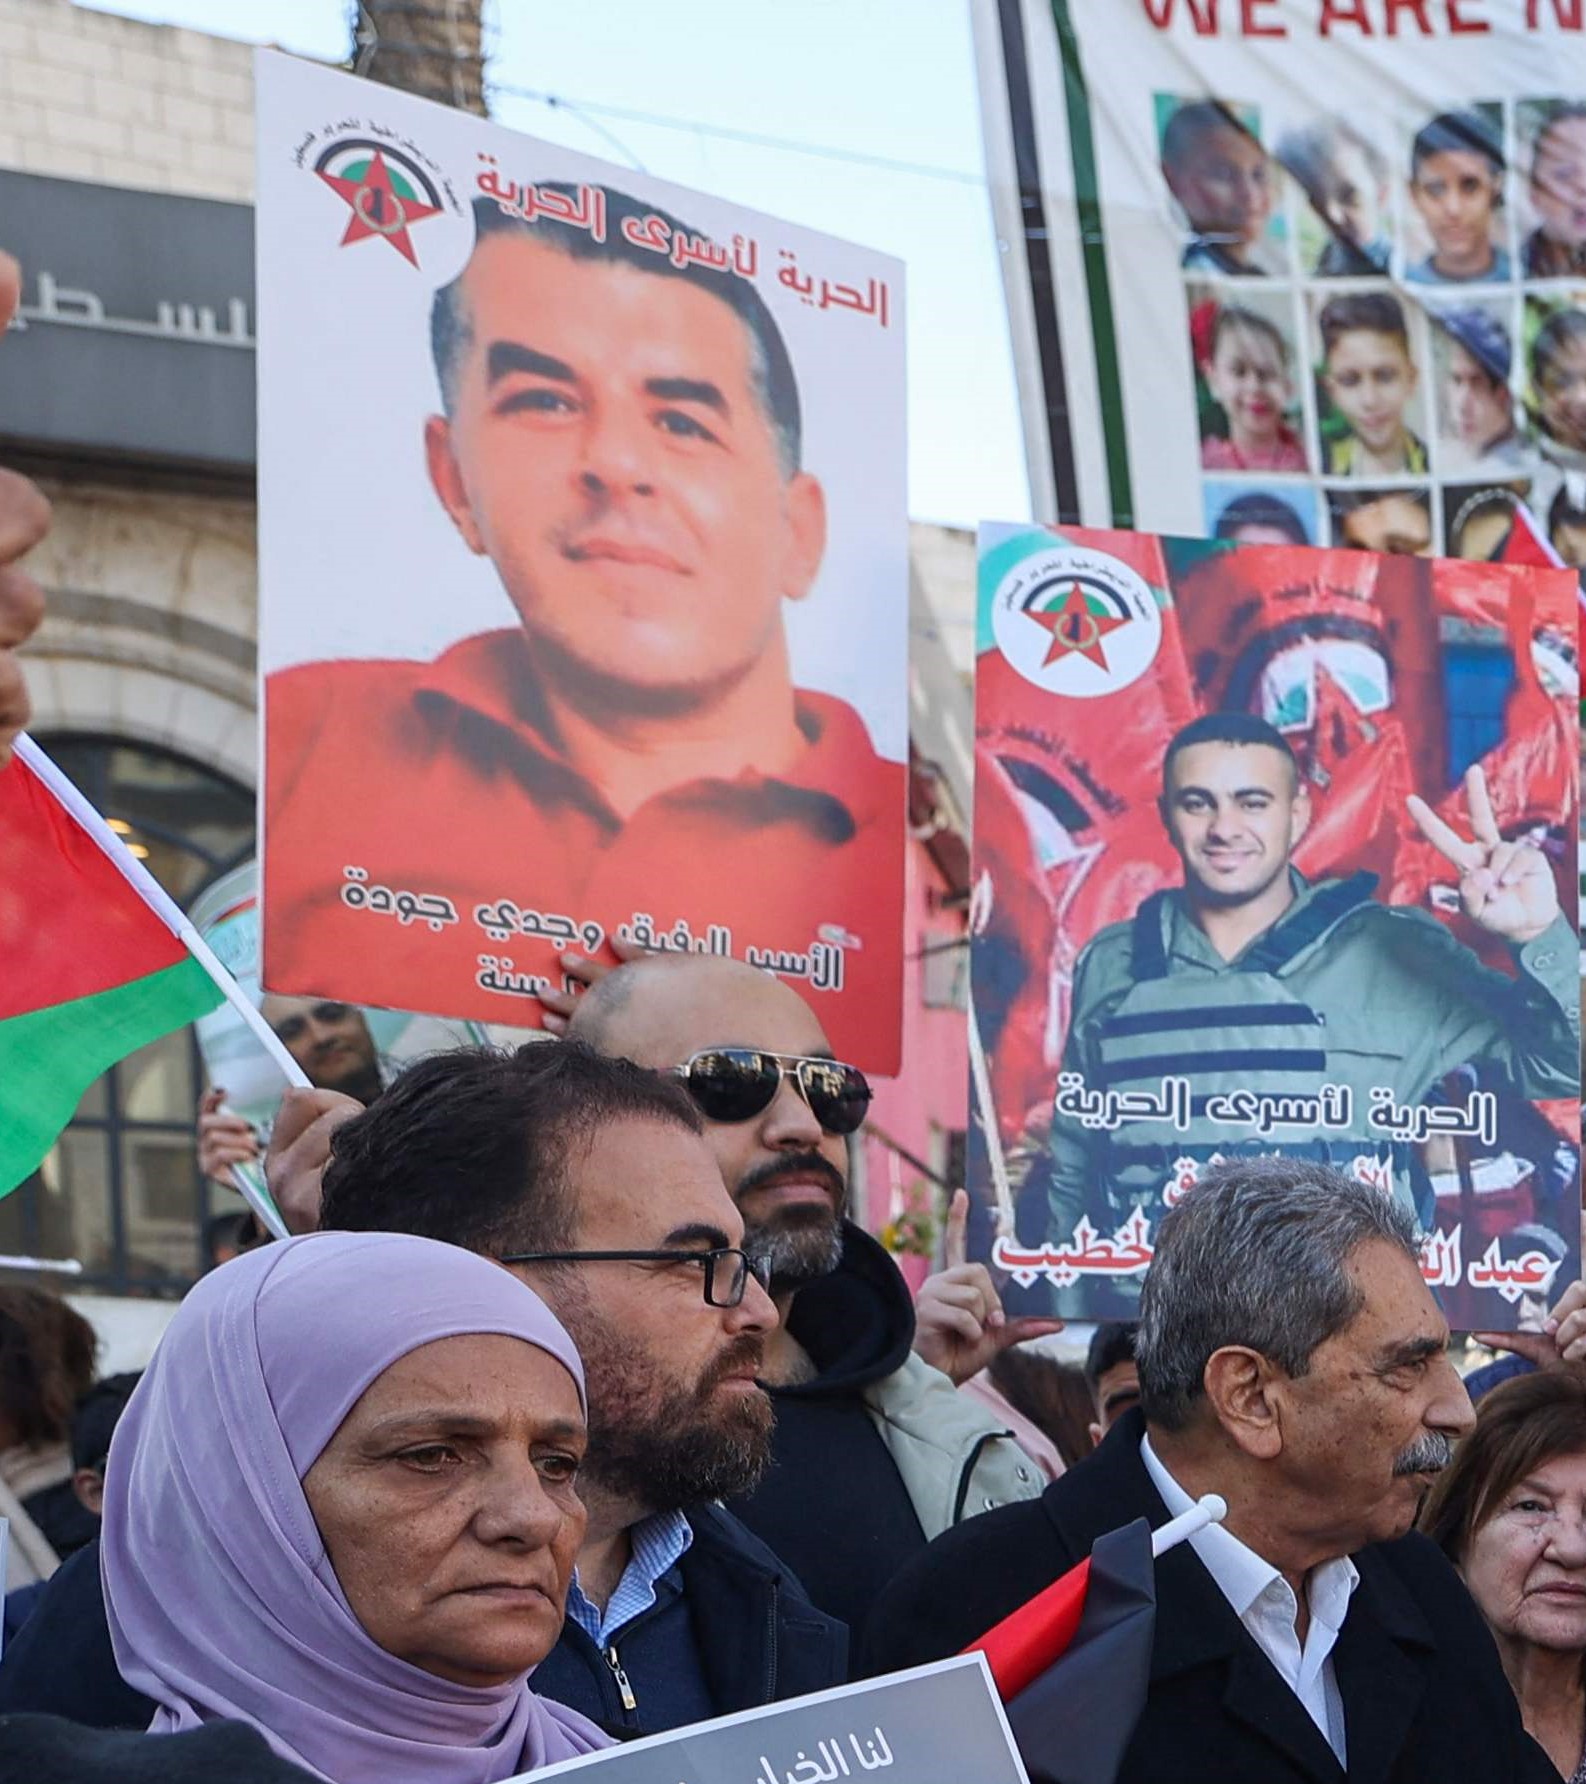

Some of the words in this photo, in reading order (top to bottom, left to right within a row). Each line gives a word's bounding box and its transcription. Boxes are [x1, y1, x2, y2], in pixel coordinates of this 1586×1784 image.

[476, 152, 607, 241] الحرية
[622, 215, 758, 277] لأسرى
[779, 248, 888, 327] الحرية
[341, 865, 459, 932] جودة
[473, 898, 604, 953] وجدي
[475, 953, 551, 998] سنة
[1055, 1071, 1190, 1130] الحرية
[1205, 1083, 1352, 1134] لأسرى
[1368, 1084, 1498, 1146] الحرية
[993, 1204, 1156, 1290] لخطيب
[848, 1726, 896, 1772] لنا
